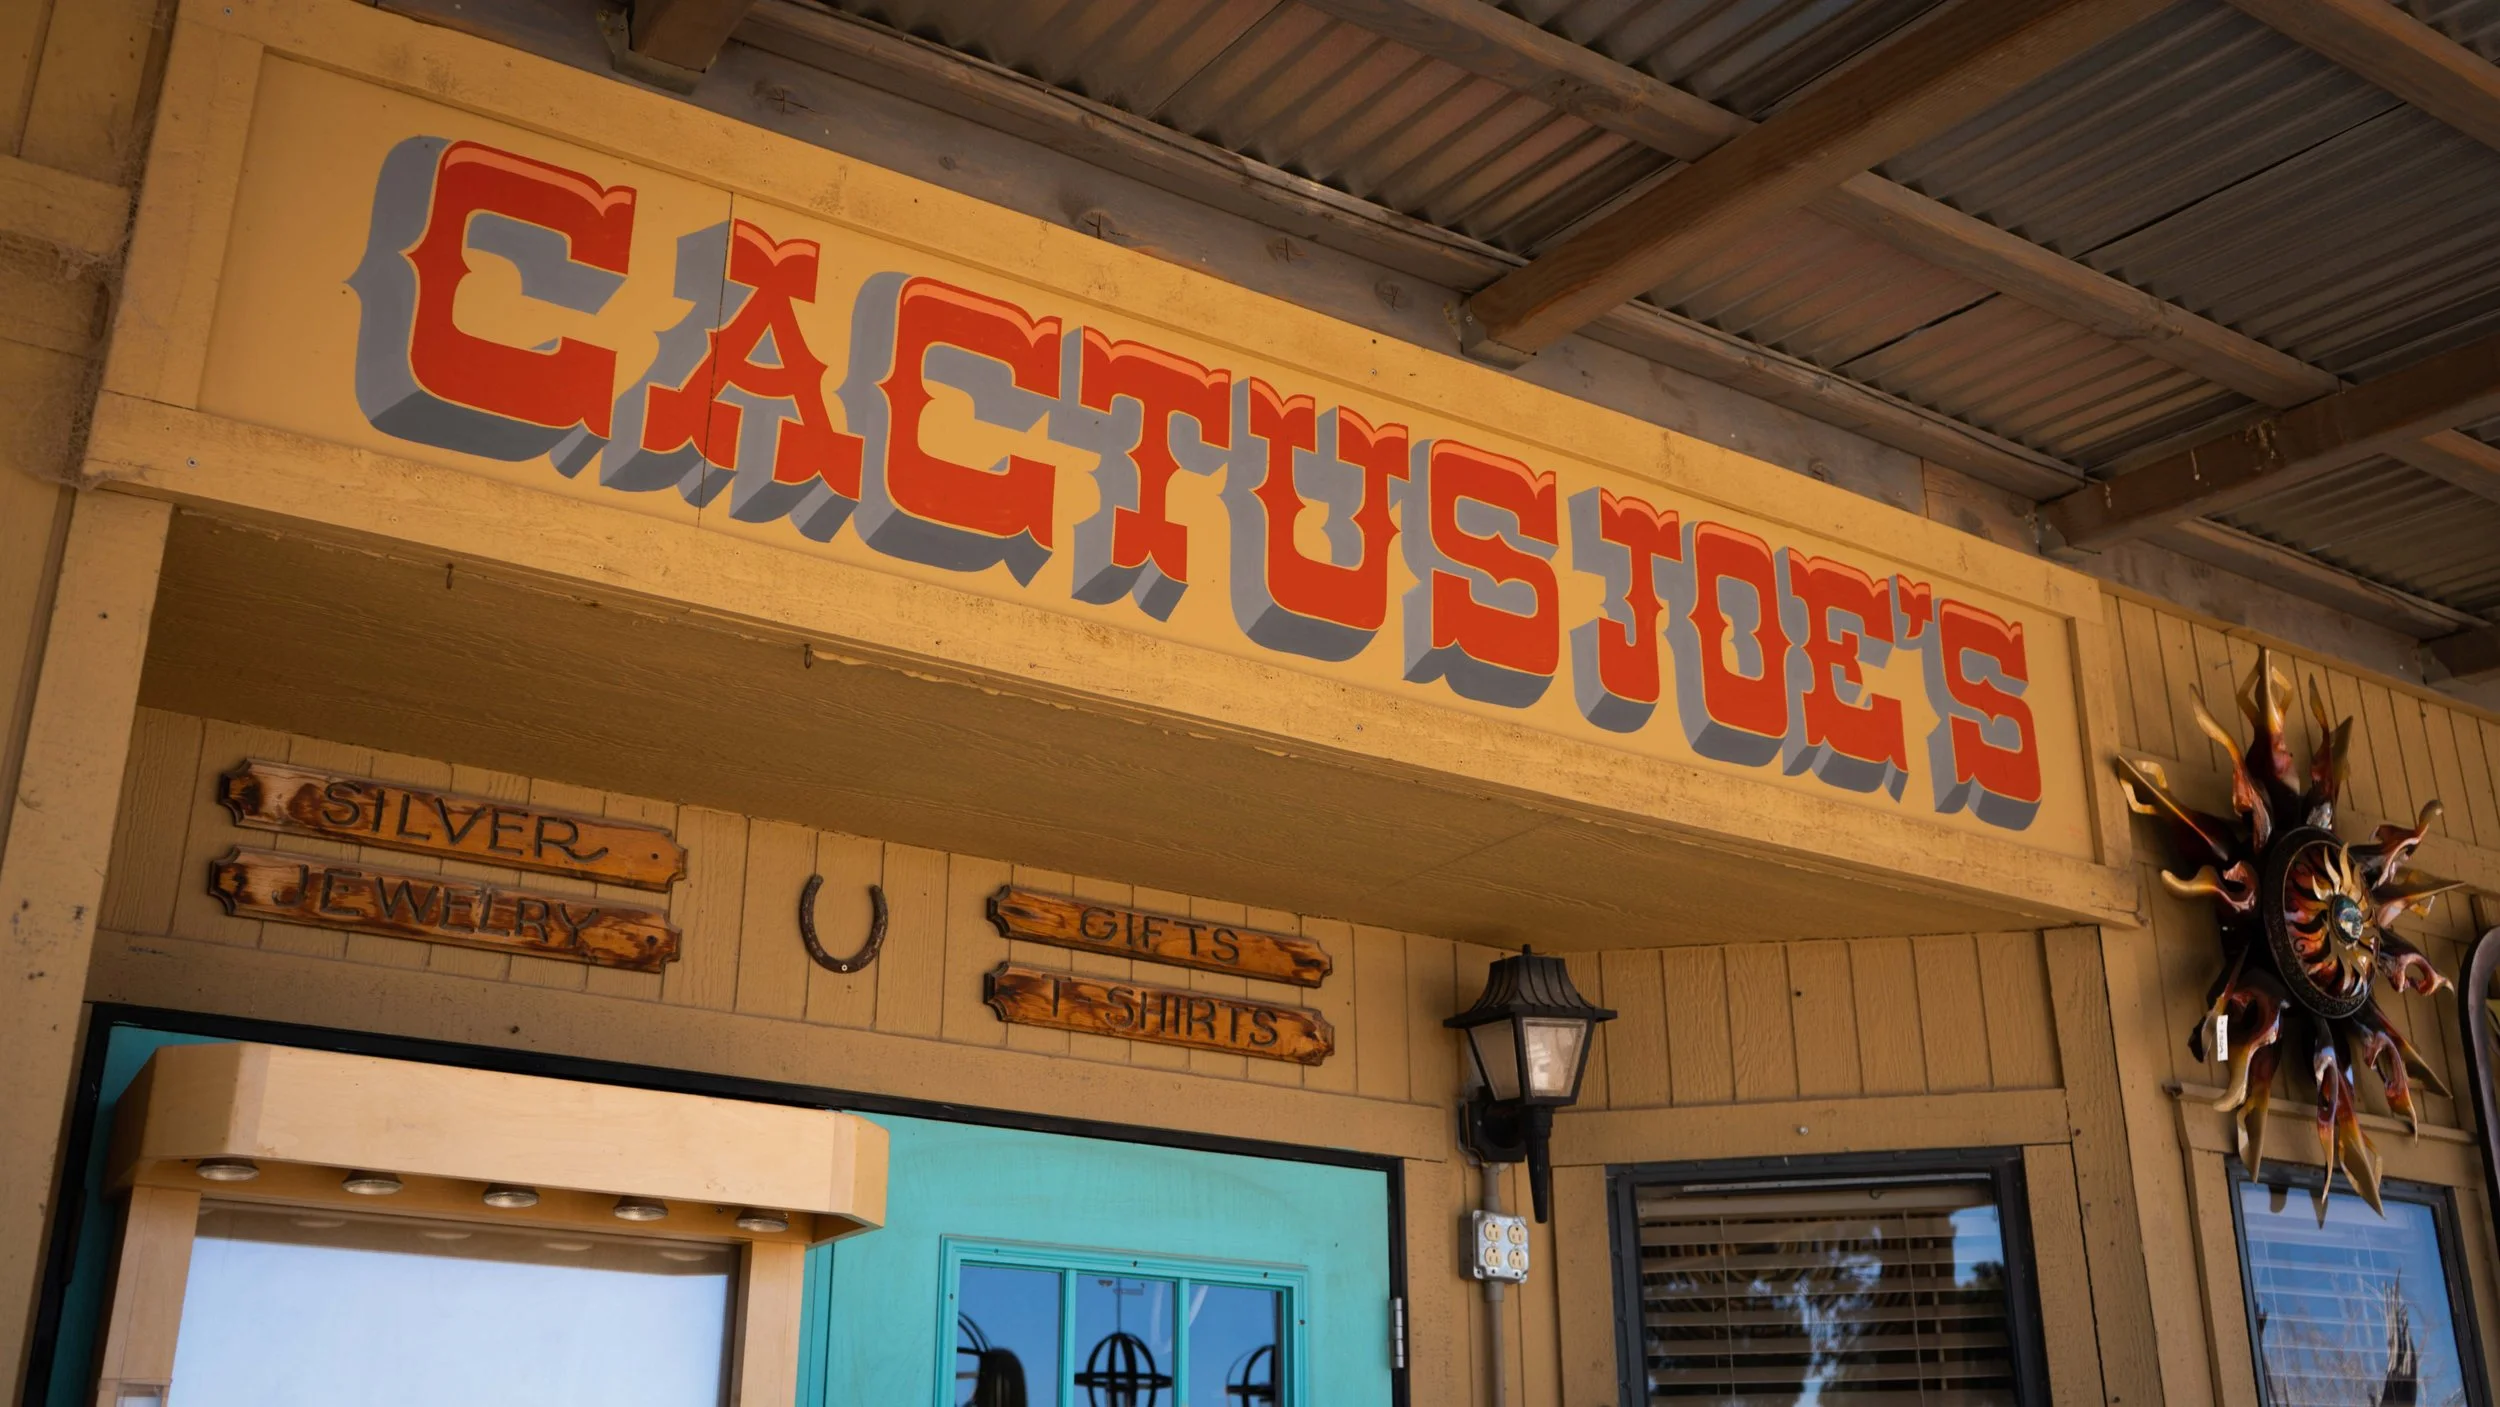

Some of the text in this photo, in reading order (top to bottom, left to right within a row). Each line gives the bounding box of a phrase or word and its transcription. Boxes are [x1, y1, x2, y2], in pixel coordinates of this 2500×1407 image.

[400, 139, 2042, 803] CACTUS JOE'S
[321, 781, 608, 863] SILVER
[271, 863, 600, 947] JEWELRY
[1079, 906, 1240, 965] GIFTS
